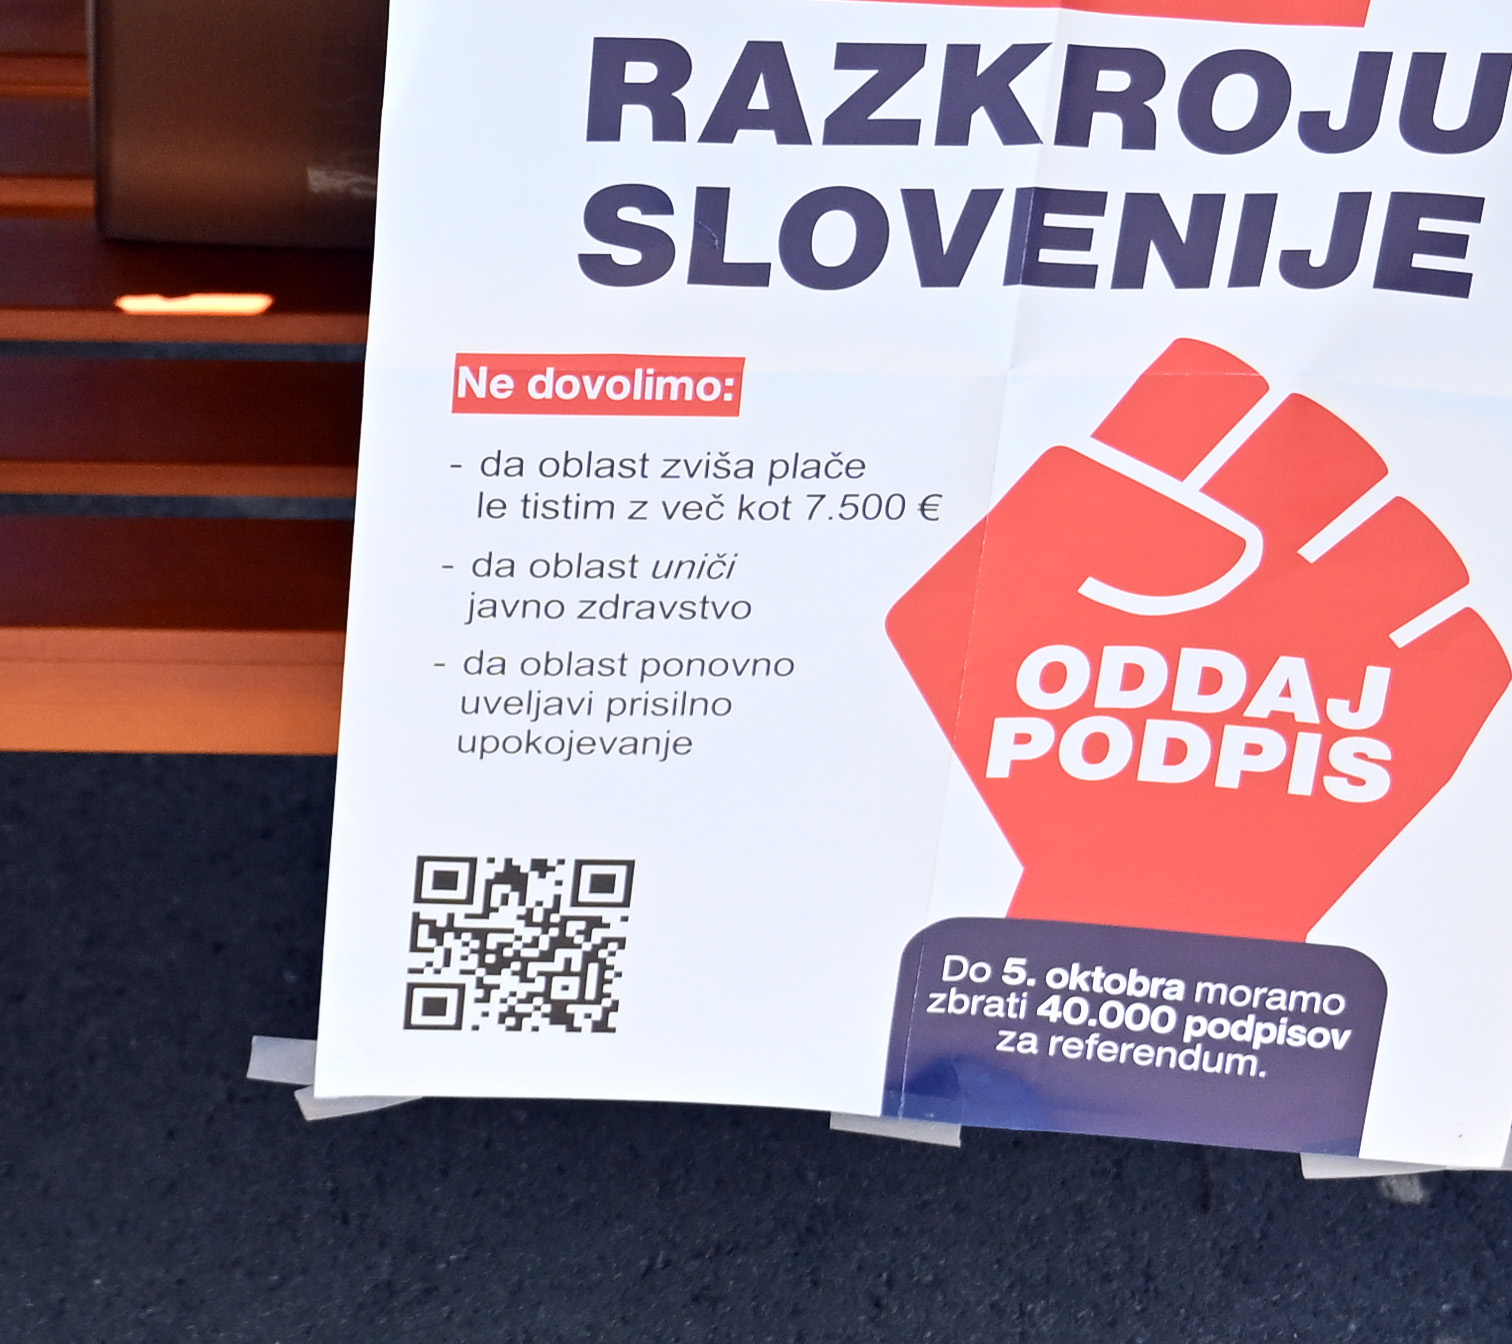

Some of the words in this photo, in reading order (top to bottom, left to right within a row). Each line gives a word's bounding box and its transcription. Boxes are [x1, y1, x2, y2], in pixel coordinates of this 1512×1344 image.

[578, 184, 1485, 299] SLOVENIJE
[458, 366, 514, 399] Ne
[528, 367, 733, 401] dovolimo:
[481, 450, 523, 477] da
[539, 451, 649, 478] oblast
[661, 452, 753, 479] zviša
[768, 452, 865, 486] plače
[478, 492, 506, 518] le
[521, 493, 614, 519] tistim
[628, 501, 648, 520] z
[662, 494, 724, 520] več
[738, 494, 791, 520] kot
[807, 494, 905, 520] 7.500
[918, 494, 942, 521] €
[1017, 645, 1391, 729] ODDAJ
[986, 716, 1391, 802] PODPIS
[942, 955, 991, 982] Do
[1002, 958, 1035, 986] 5.
[1046, 963, 1185, 1001] oktobra
[1195, 982, 1345, 1015] moramo
[927, 987, 1027, 1019] zbrati
[1037, 995, 1176, 1033] 40.000
[1183, 1014, 1351, 1050] podpisov
[996, 1031, 1038, 1054] za
[1049, 1033, 1266, 1077] referendum.
